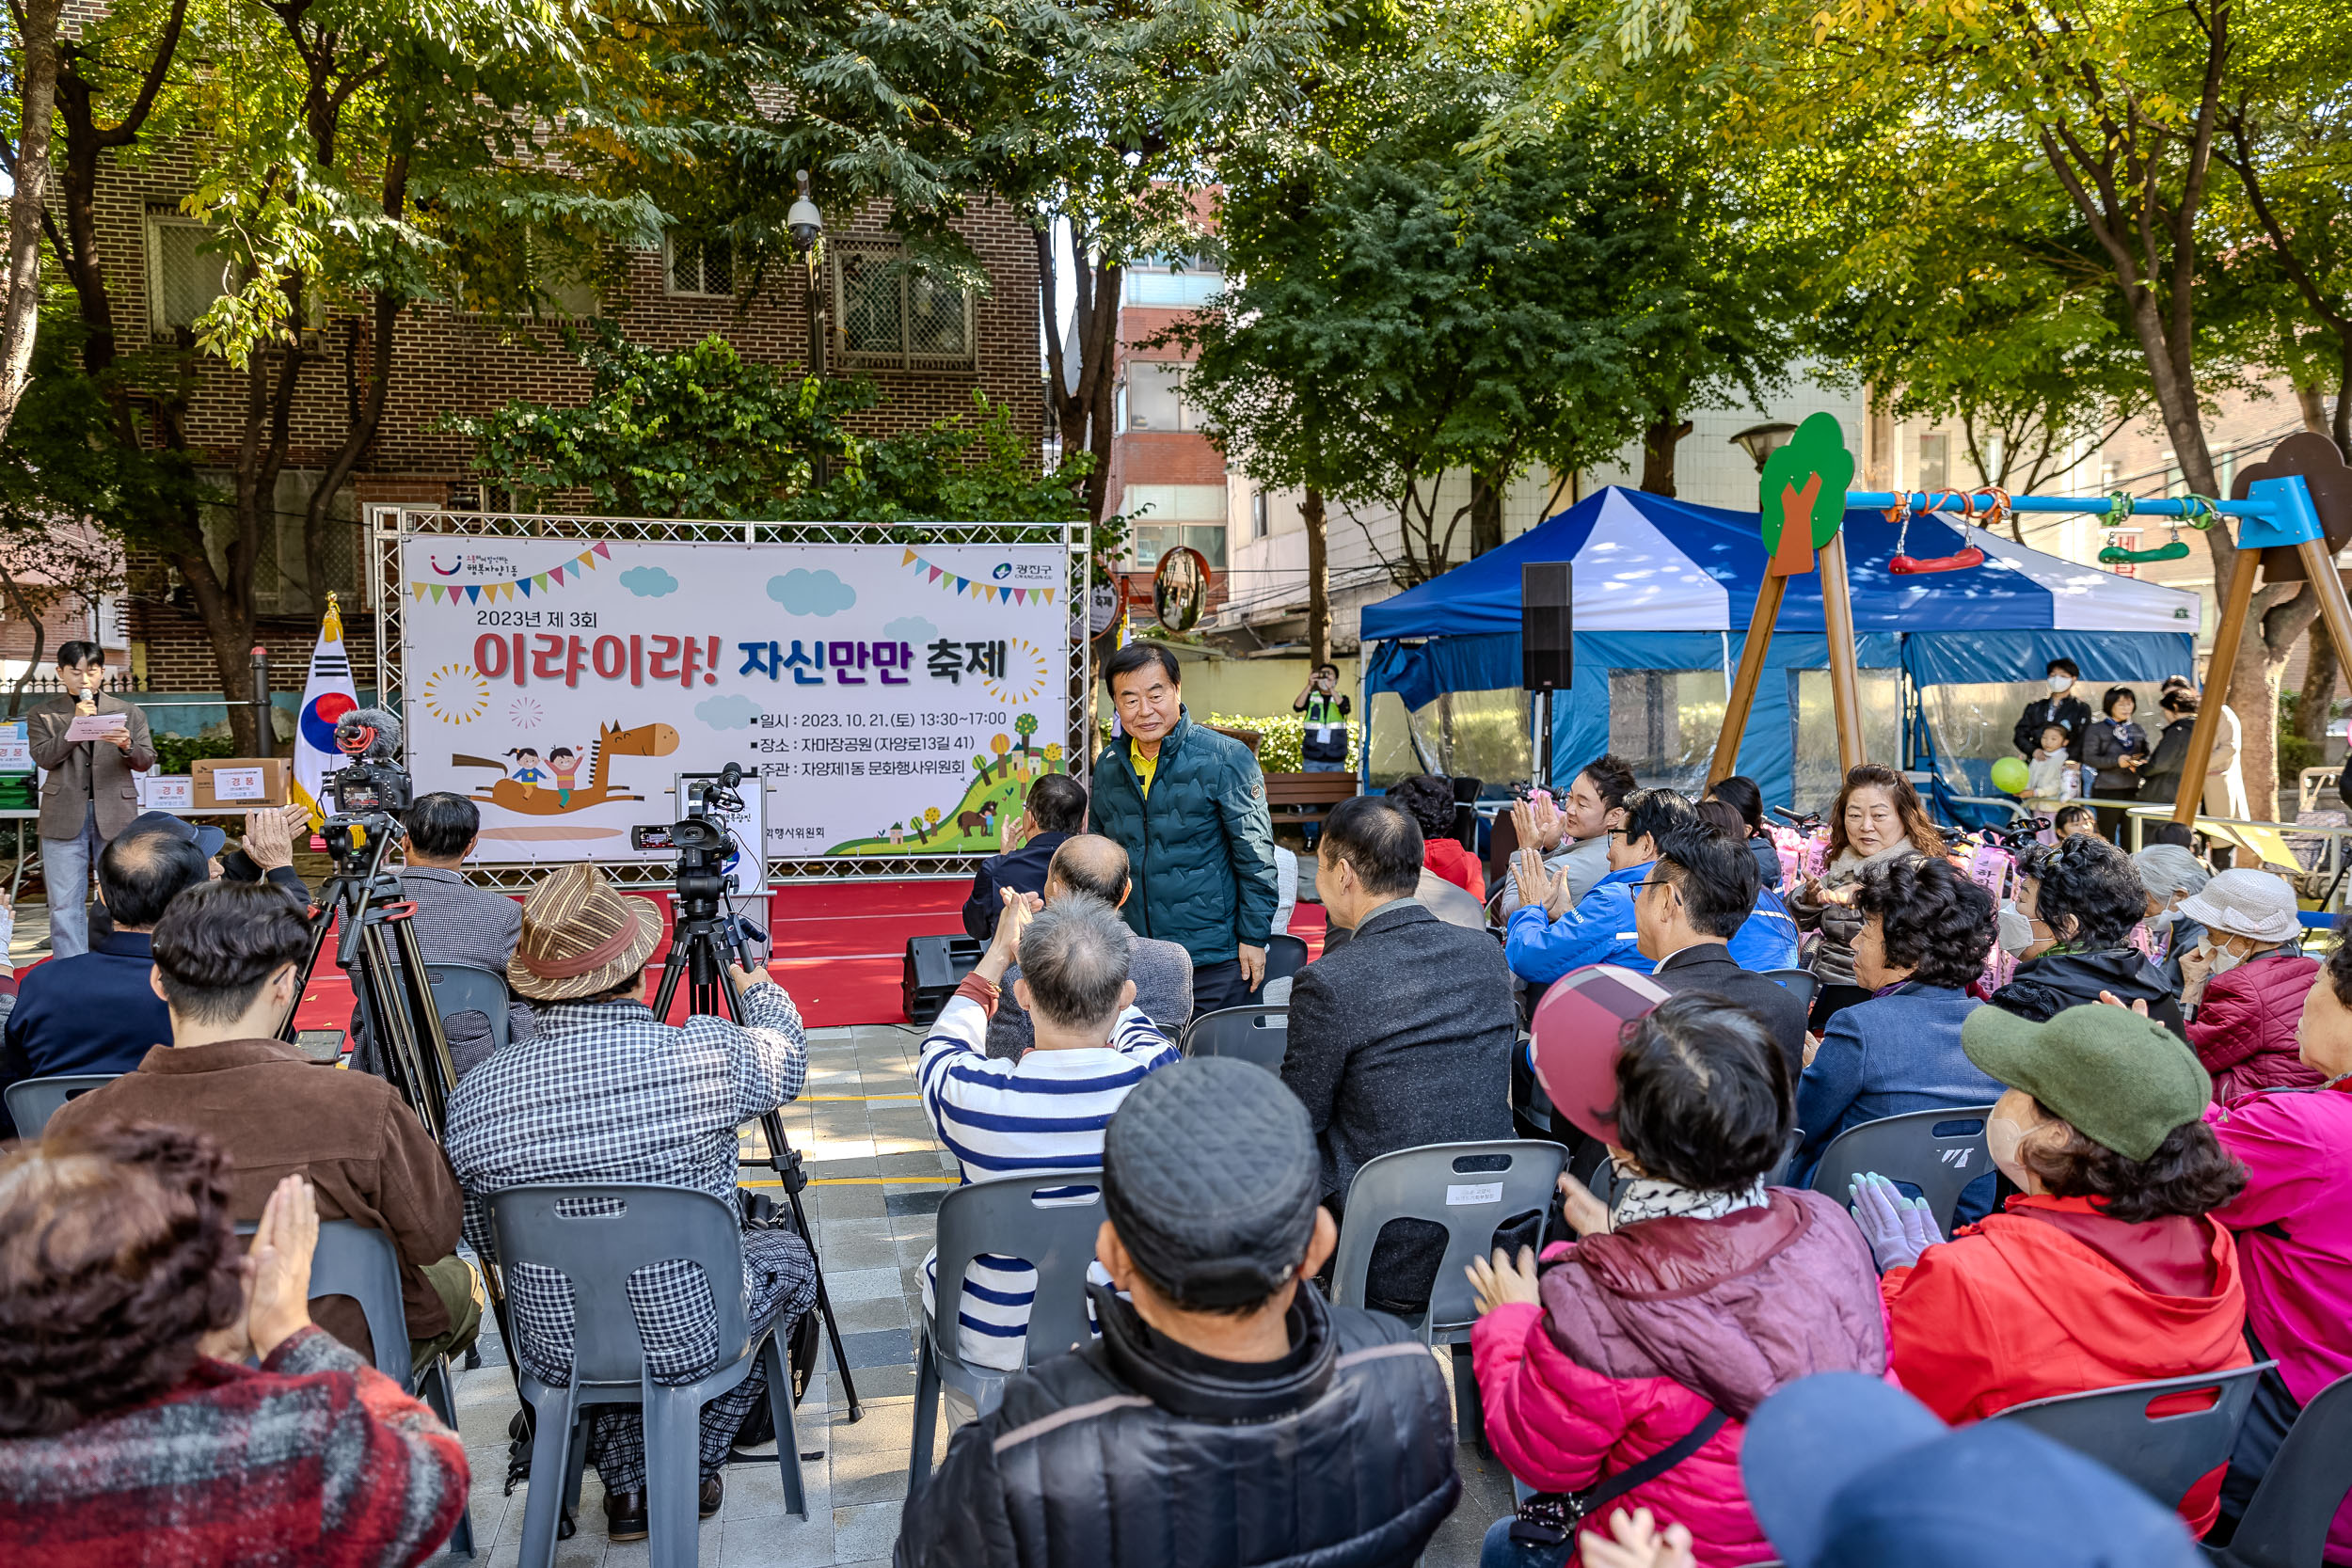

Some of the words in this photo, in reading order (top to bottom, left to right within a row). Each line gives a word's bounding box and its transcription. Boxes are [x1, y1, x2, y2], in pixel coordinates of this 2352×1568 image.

[467, 563, 517, 577] 행복자양1동
[1015, 564, 1053, 575] 광진구
[477, 610, 541, 627] 2023년
[548, 611, 564, 627] 제
[569, 611, 597, 628] 3회
[473, 633, 721, 688] 이랴이랴!
[738, 640, 914, 685] 자신만만
[927, 639, 1006, 684] 축제
[760, 714, 789, 728] 일시
[802, 714, 842, 727] 2023.
[846, 714, 866, 727] 10.
[920, 712, 1007, 727] 13:30~17:00
[760, 738, 789, 752] 장소
[954, 736, 975, 751] 41)
[761, 762, 789, 777] 주관
[801, 762, 866, 776] 자양제1동
[868, 760, 964, 776] 문화행사위원회
